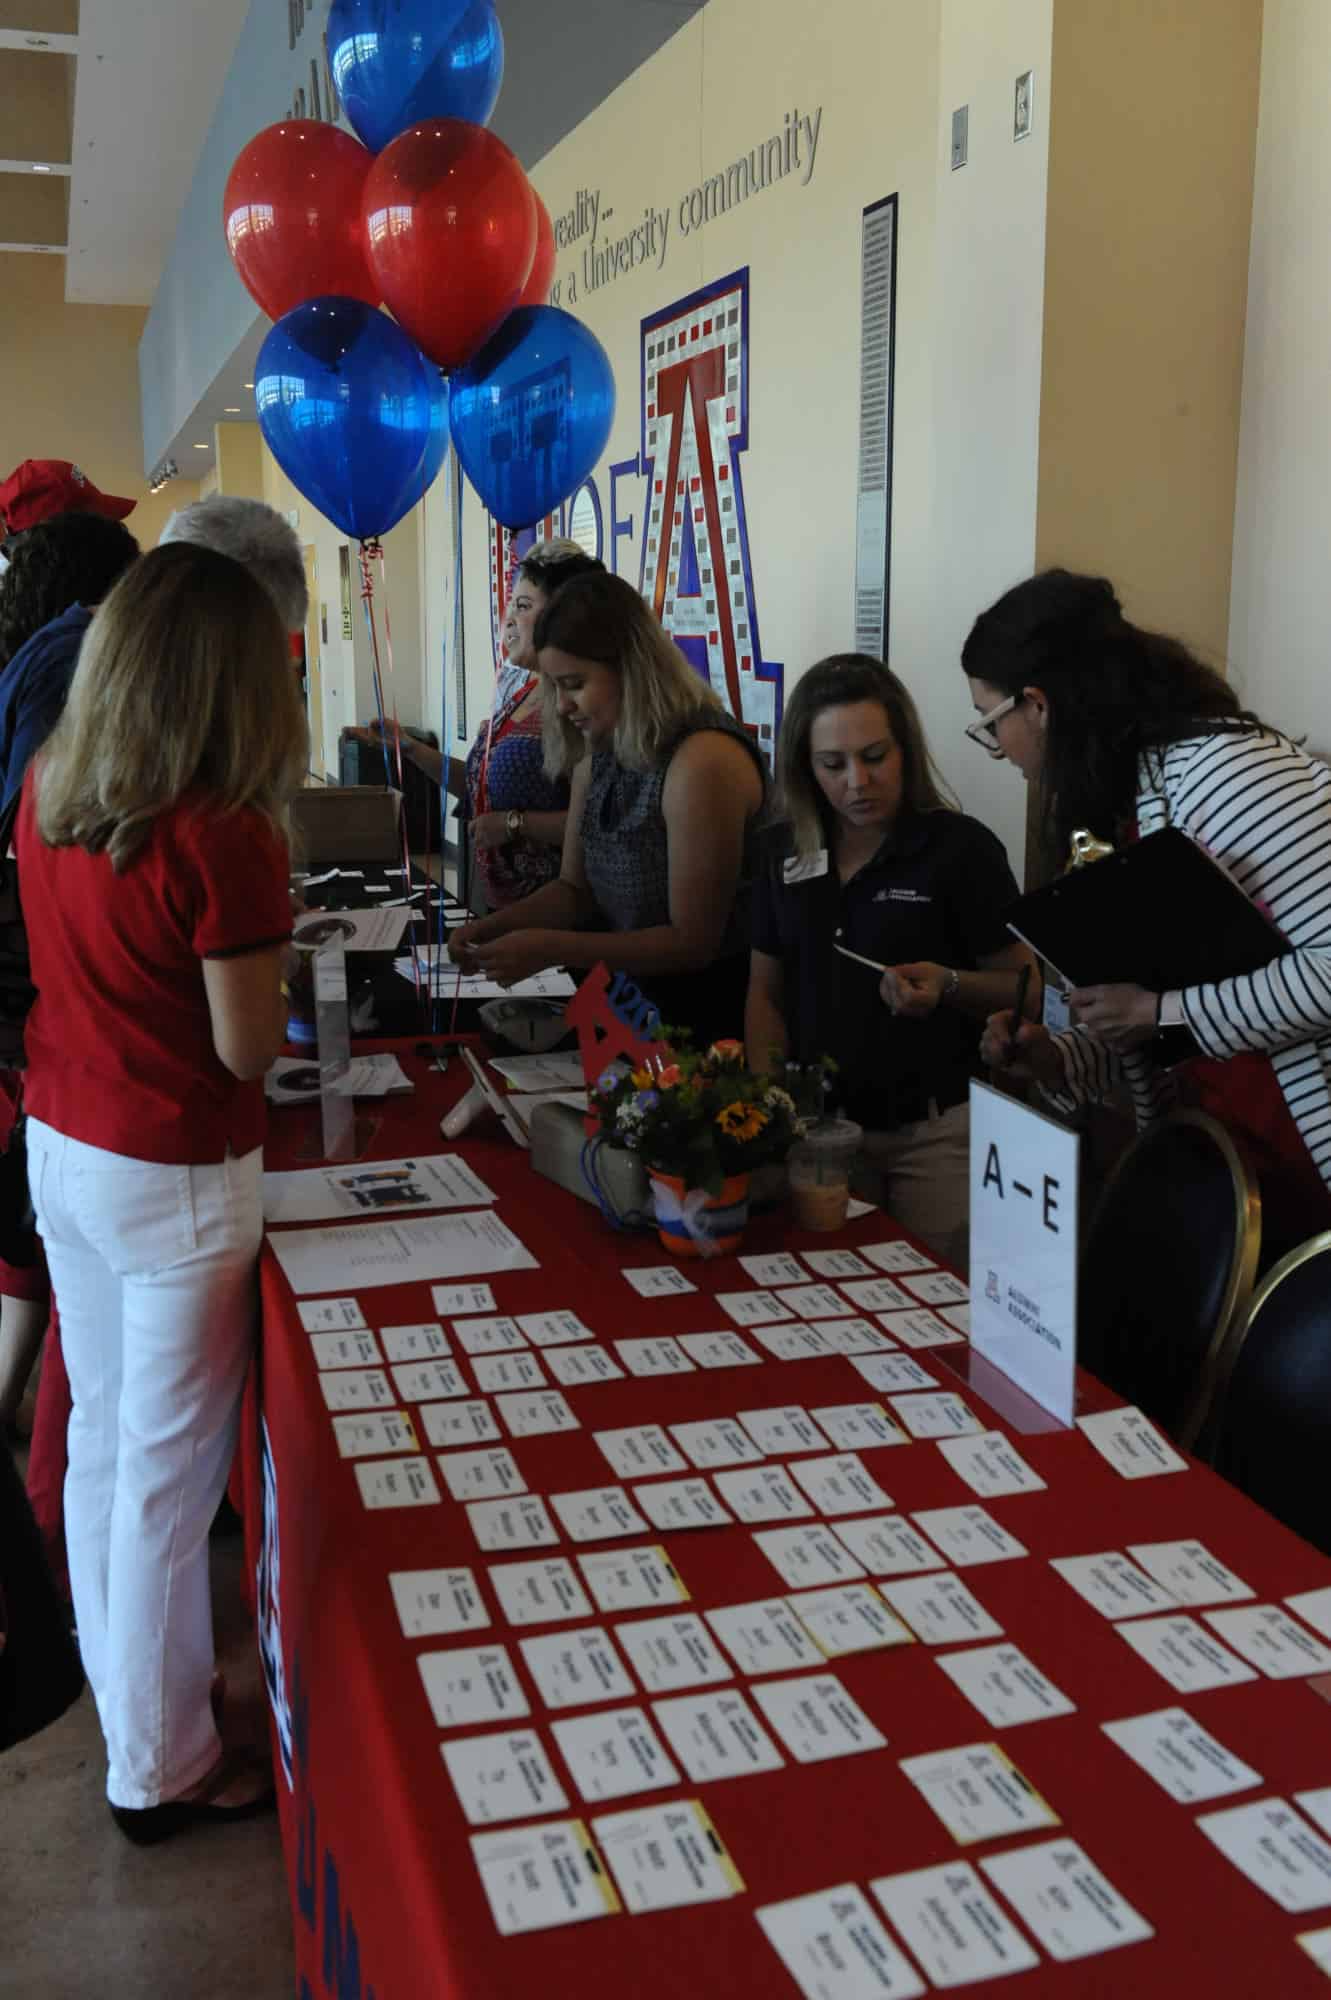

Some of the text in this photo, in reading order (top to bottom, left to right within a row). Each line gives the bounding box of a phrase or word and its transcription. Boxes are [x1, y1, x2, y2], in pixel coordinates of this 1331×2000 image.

[568, 105, 823, 304] a University community
[640, 265, 785, 772] A
[1008, 1301, 1063, 1351] ASSOCIATION
